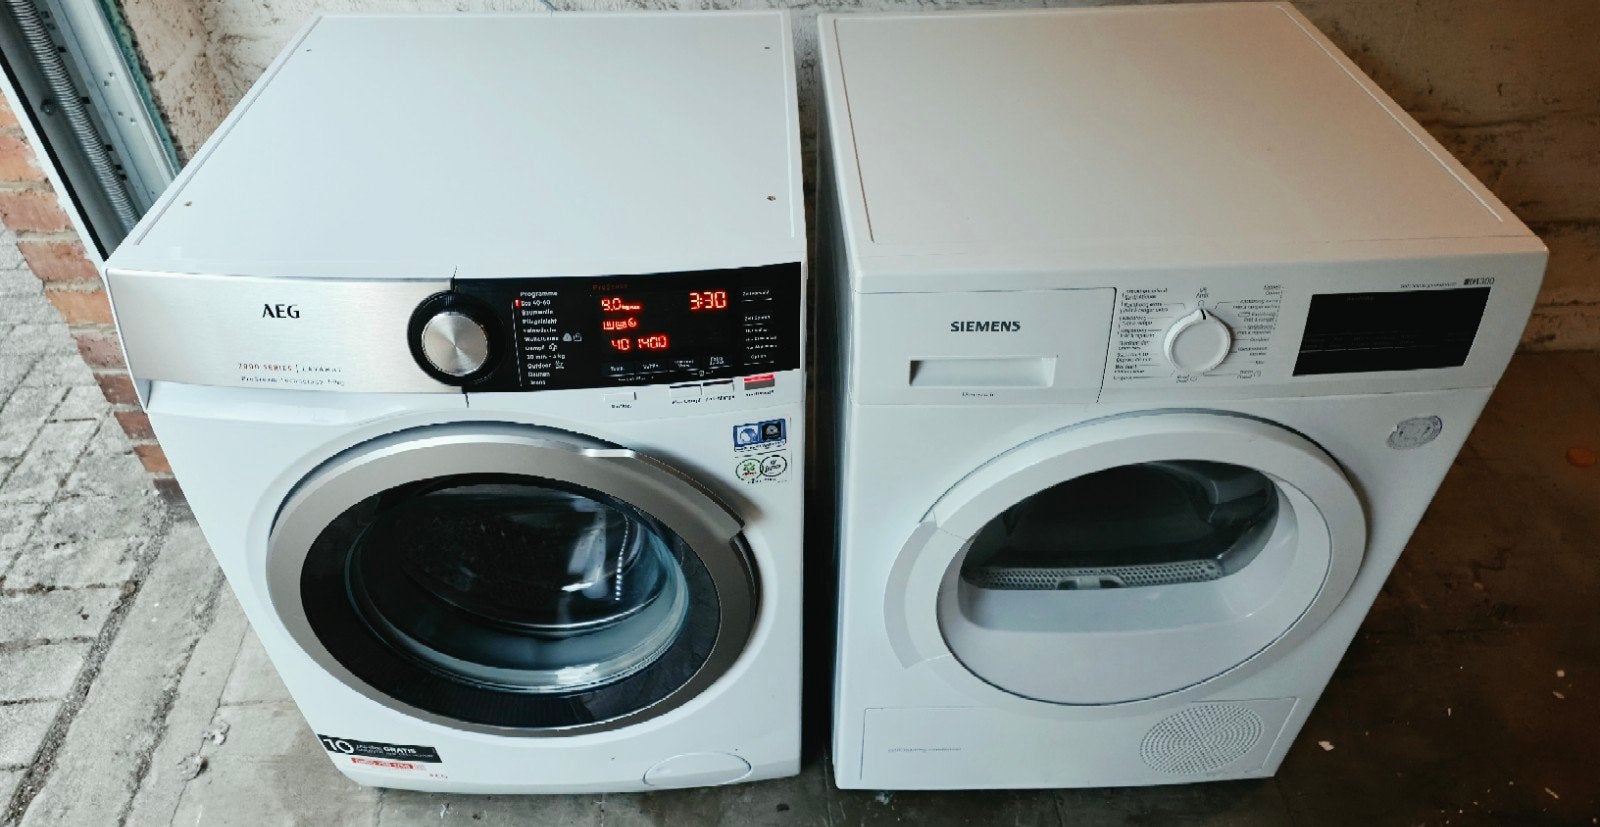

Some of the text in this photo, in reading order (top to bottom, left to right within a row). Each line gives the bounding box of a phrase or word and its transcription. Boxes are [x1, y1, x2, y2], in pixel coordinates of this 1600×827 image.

[689, 291, 727, 310] 3:30
[262, 303, 301, 319] AEG
[950, 320, 1022, 333] SIEMENS
[322, 738, 355, 754] 10
[383, 746, 417, 755] GRATIS
